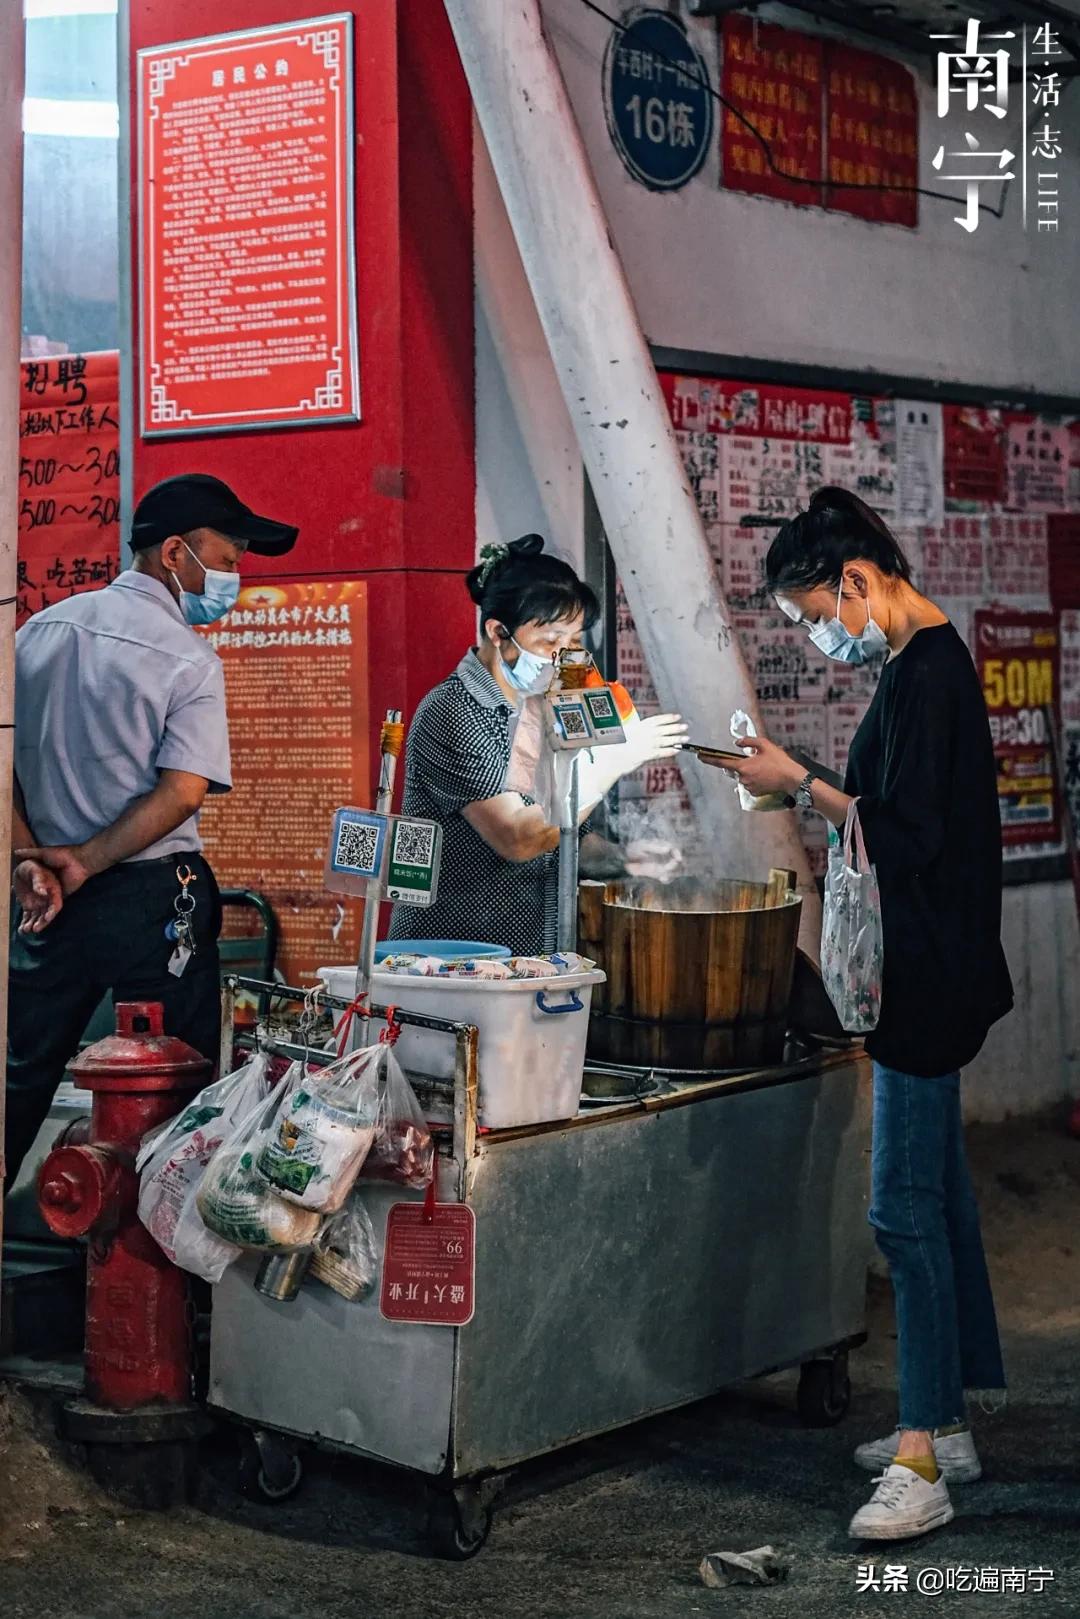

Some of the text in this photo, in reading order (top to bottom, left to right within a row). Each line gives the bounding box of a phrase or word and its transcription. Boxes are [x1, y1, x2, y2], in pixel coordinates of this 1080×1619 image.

[625, 94, 695, 148] 16栋
[25, 355, 88, 406] 招聘
[983, 658, 1054, 709] 50M
